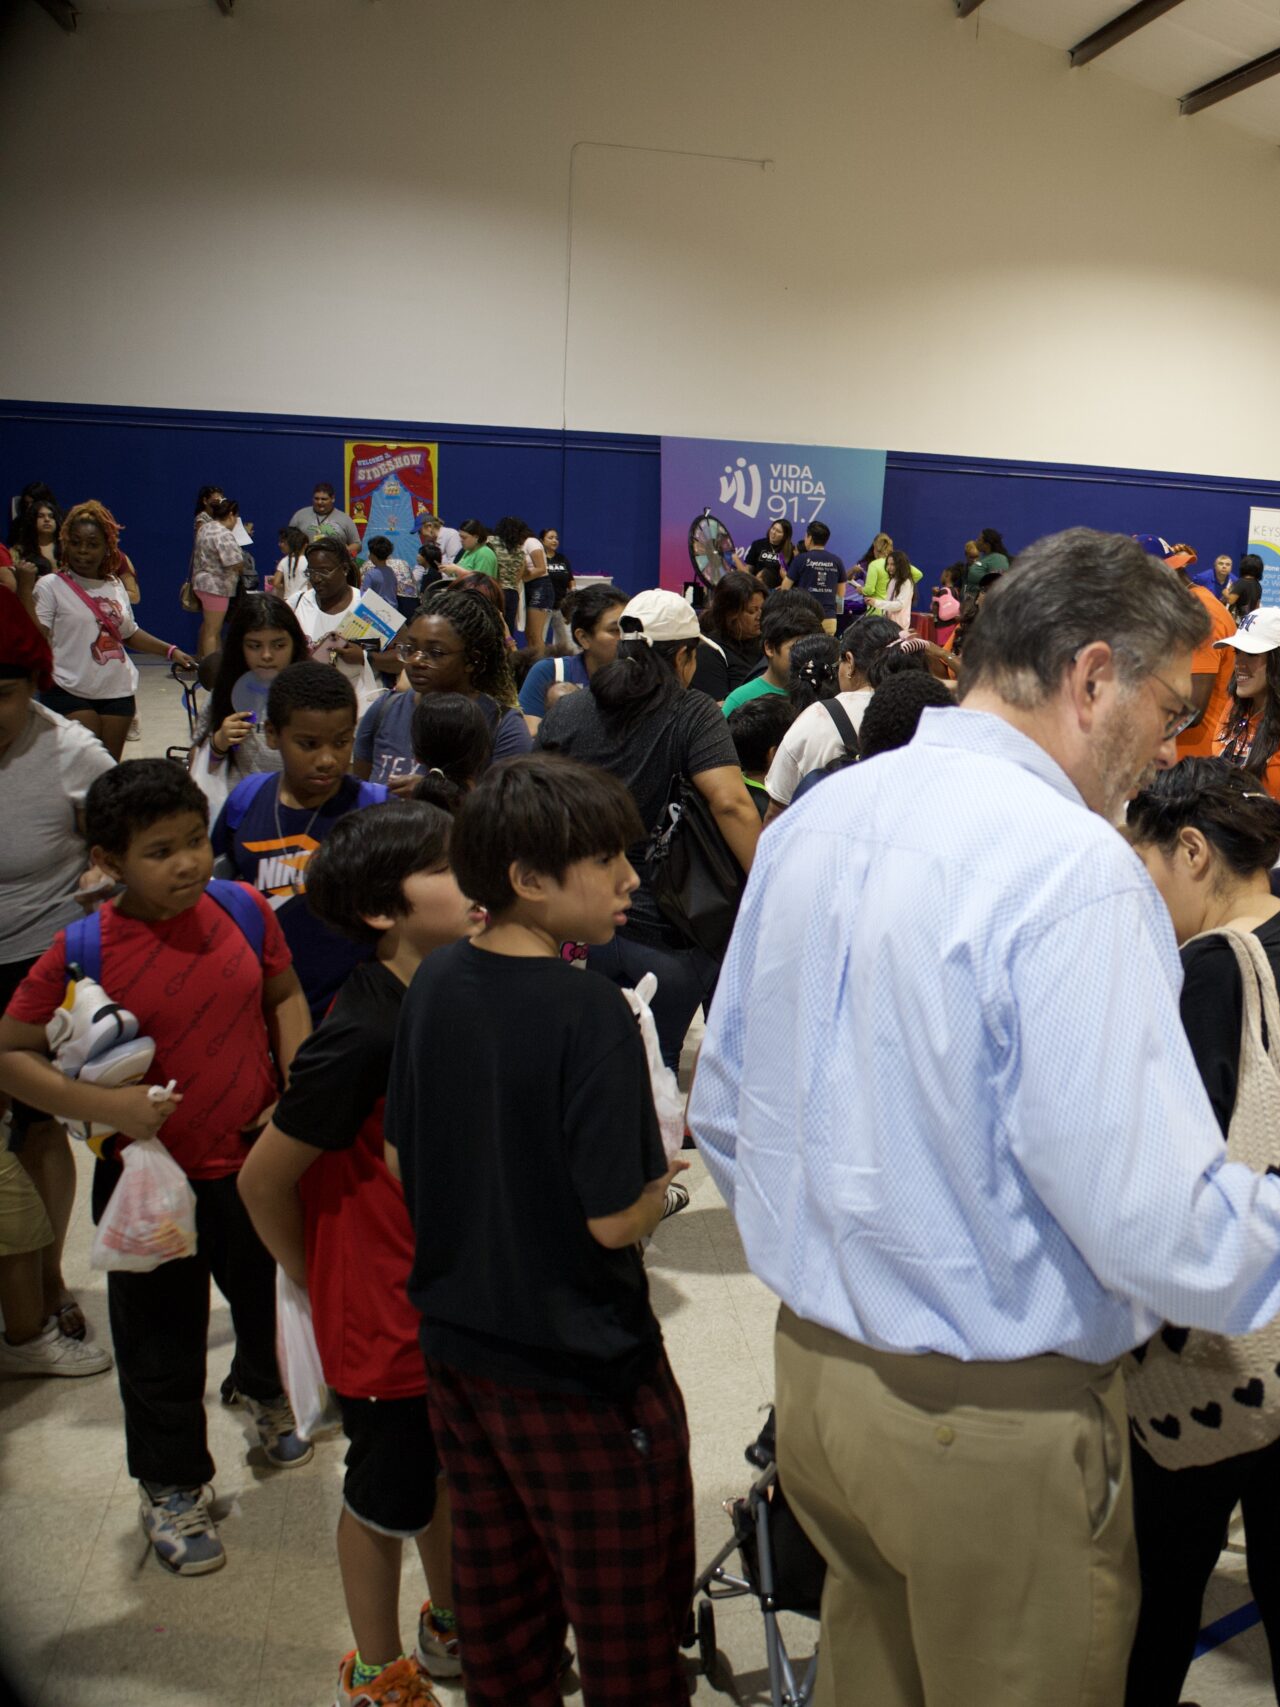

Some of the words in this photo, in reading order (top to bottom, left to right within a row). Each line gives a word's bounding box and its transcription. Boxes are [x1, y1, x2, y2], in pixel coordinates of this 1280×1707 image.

[358, 453, 421, 481] SIDESHOW
[770, 463, 813, 479] VIDA
[769, 478, 826, 495] UNIDA
[767, 494, 826, 523] 91.7
[762, 552, 780, 561] ORA
[379, 754, 421, 780] TEX
